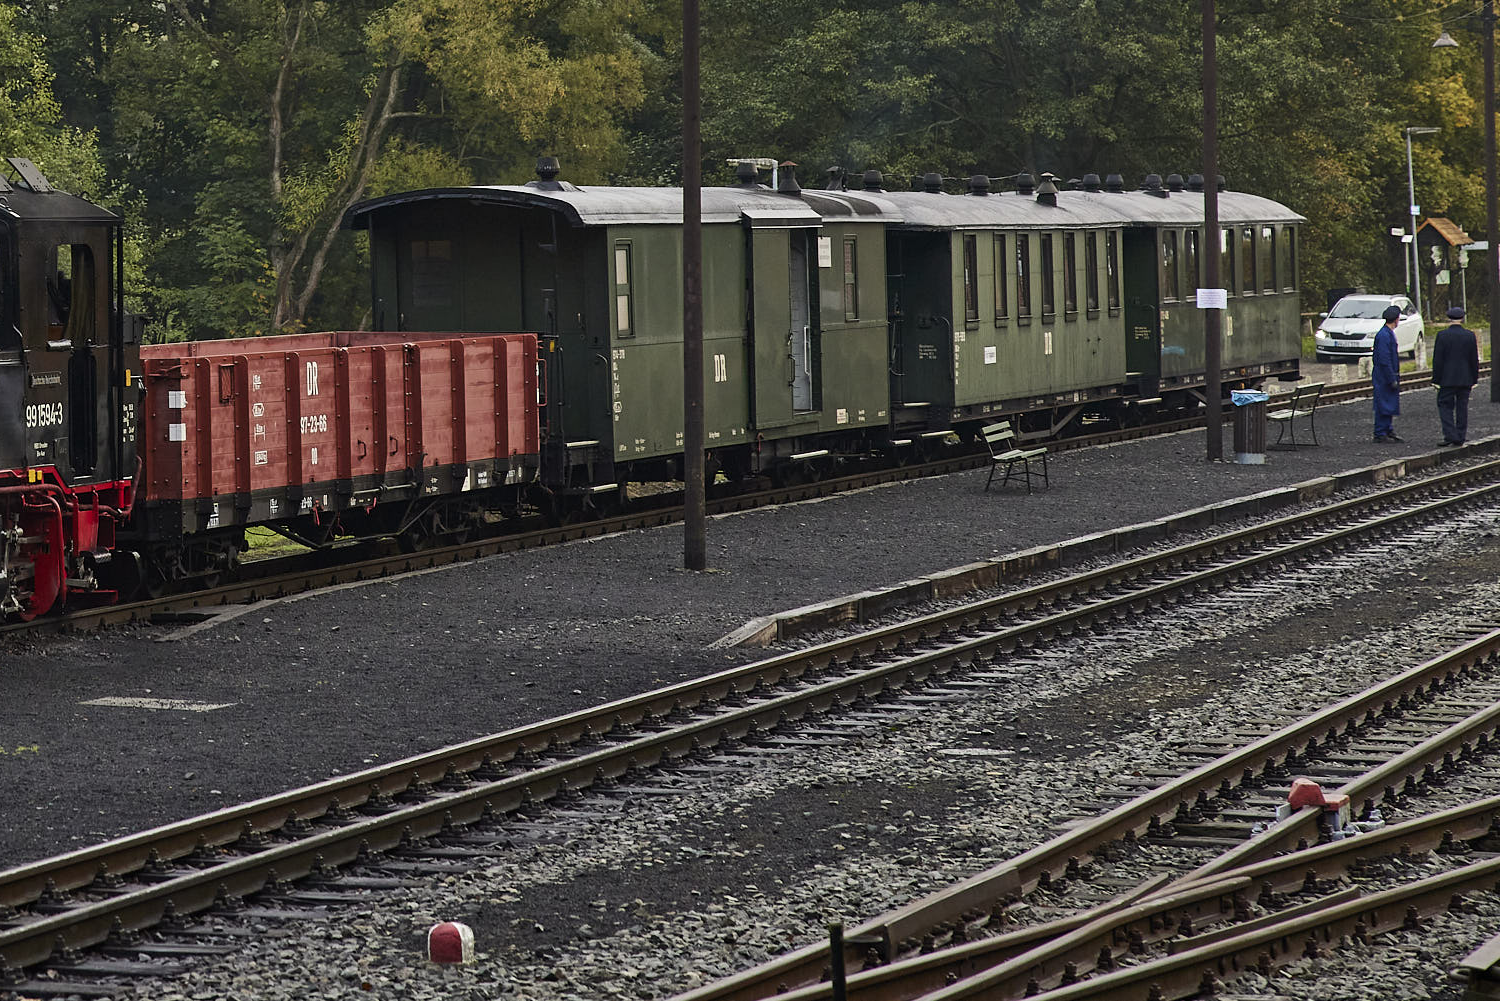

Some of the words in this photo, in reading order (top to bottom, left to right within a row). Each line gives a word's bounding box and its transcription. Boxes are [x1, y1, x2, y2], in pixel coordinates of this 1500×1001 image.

[306, 361, 319, 396] DR
[26, 404, 37, 428] 99
[37, 402, 63, 427] 1594-3
[300, 414, 328, 434] 97-23-66
